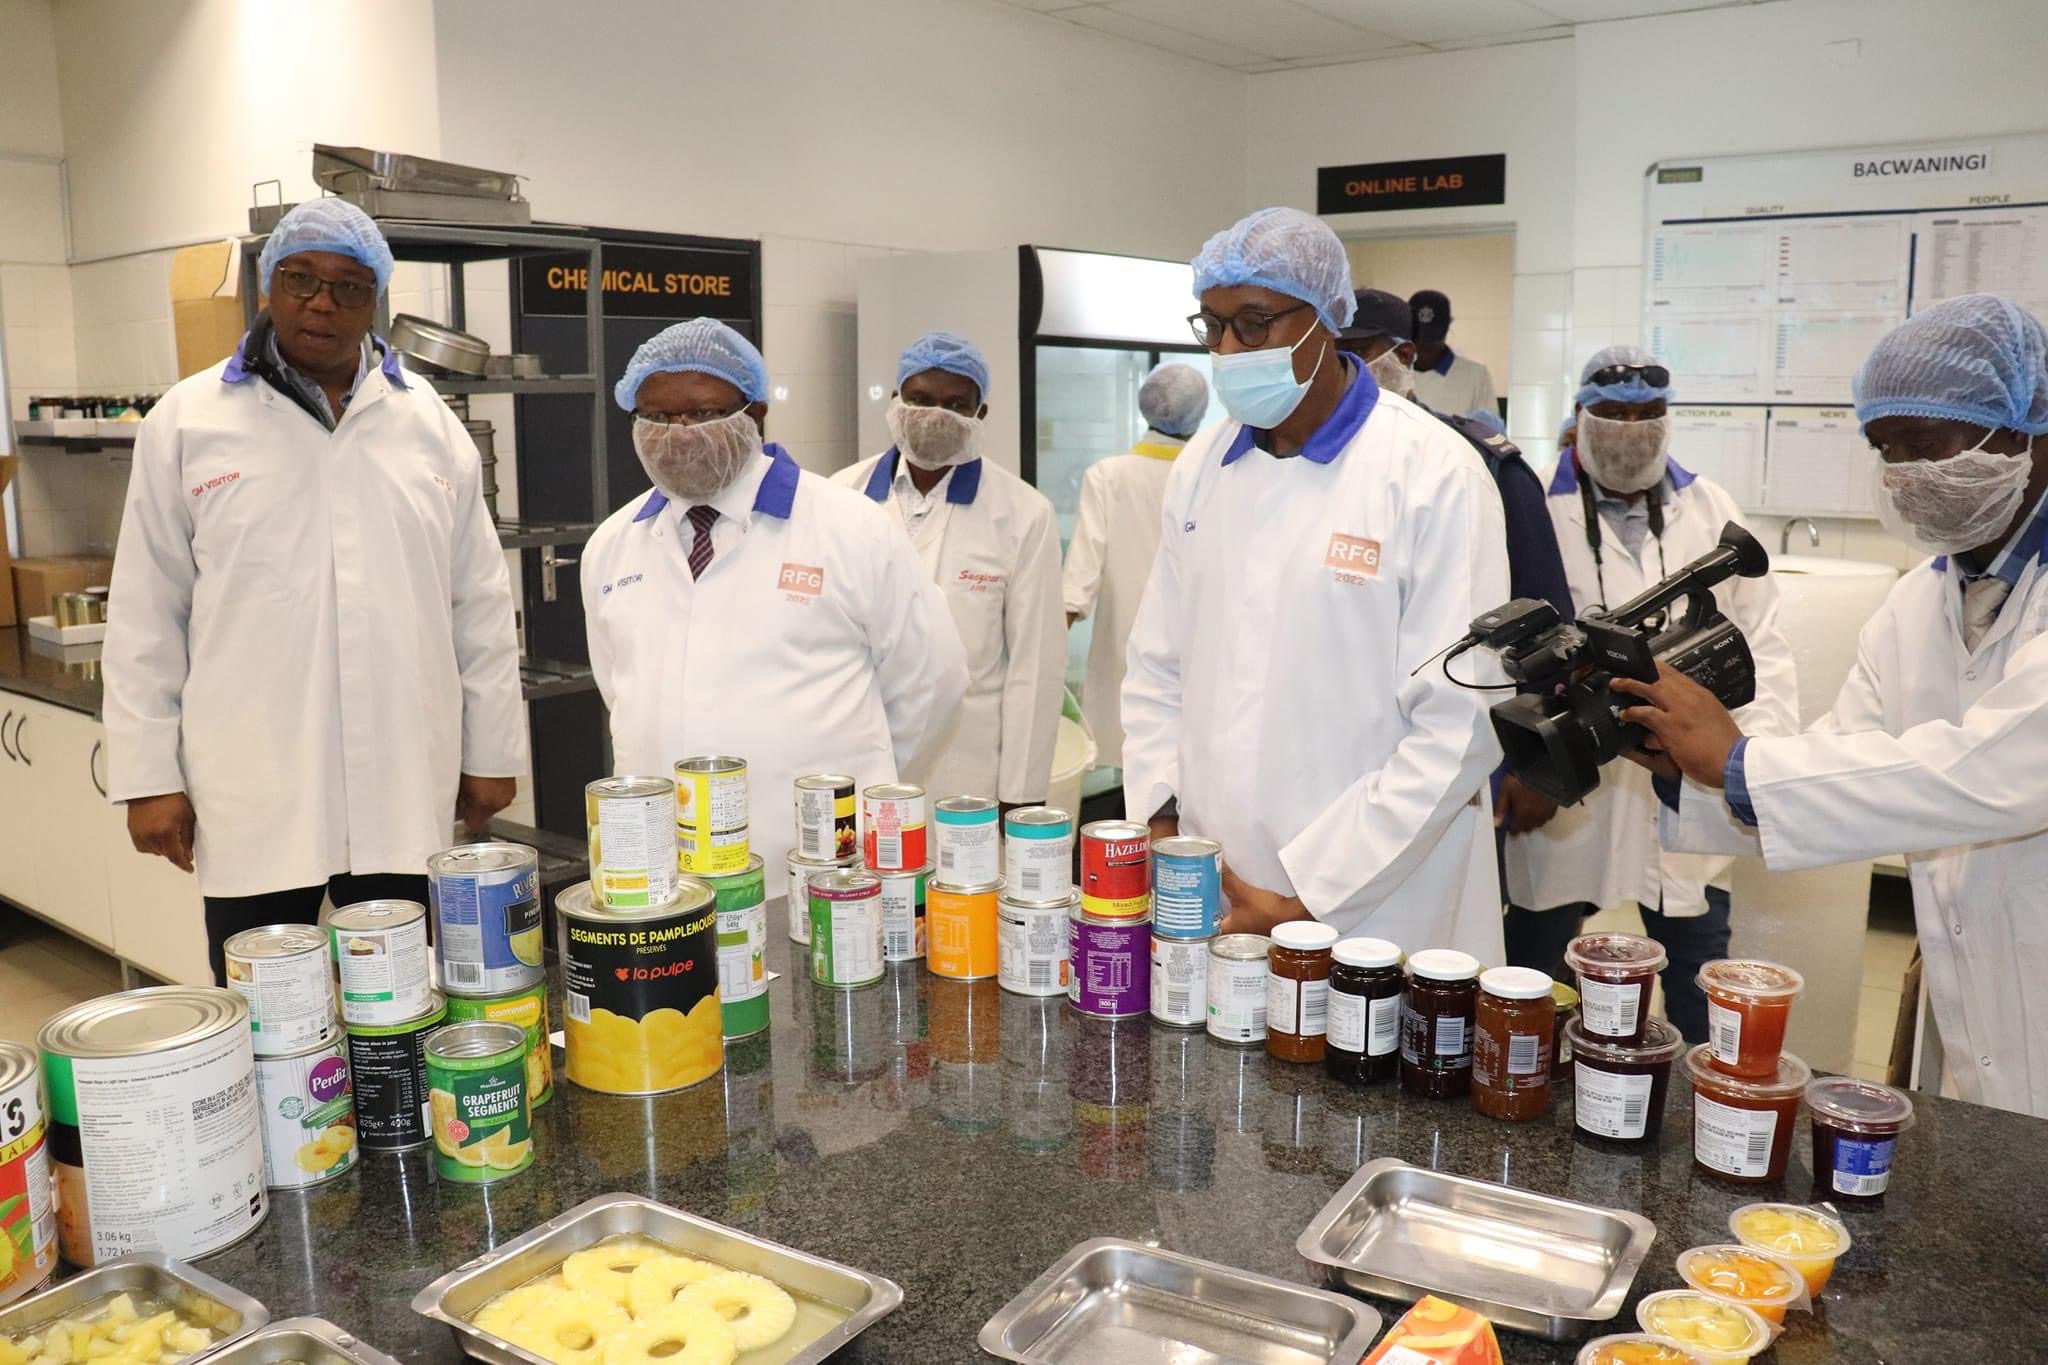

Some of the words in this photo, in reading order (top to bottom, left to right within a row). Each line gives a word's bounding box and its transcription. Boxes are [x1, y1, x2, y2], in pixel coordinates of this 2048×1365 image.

[1853, 154, 1987, 178] BACWANINGI
[1345, 177, 1417, 196] ONLINE
[1423, 173, 1463, 191] LAB
[1969, 194, 2011, 204] PEOPLE
[1746, 205, 1784, 215] QUALITY
[665, 273, 731, 296] STORE
[1709, 410, 1732, 418] PLAN
[205, 471, 240, 492] VISITOR
[1330, 541, 1377, 567] RFG
[782, 568, 822, 588] RFG
[1335, 572, 1365, 586] 2022
[1713, 636, 1736, 651] SONY
[570, 928, 627, 946] SEGMENTS
[629, 932, 648, 945] DE
[633, 968, 648, 980] la
[649, 959, 694, 980] pulpe
[312, 1067, 347, 1092] Perdiz
[462, 1083, 521, 1106] GRAPEFRUIT
[468, 1097, 519, 1118] SEGMENTS
[96, 1231, 117, 1242] 3.06
[118, 1231, 131, 1243] kg
